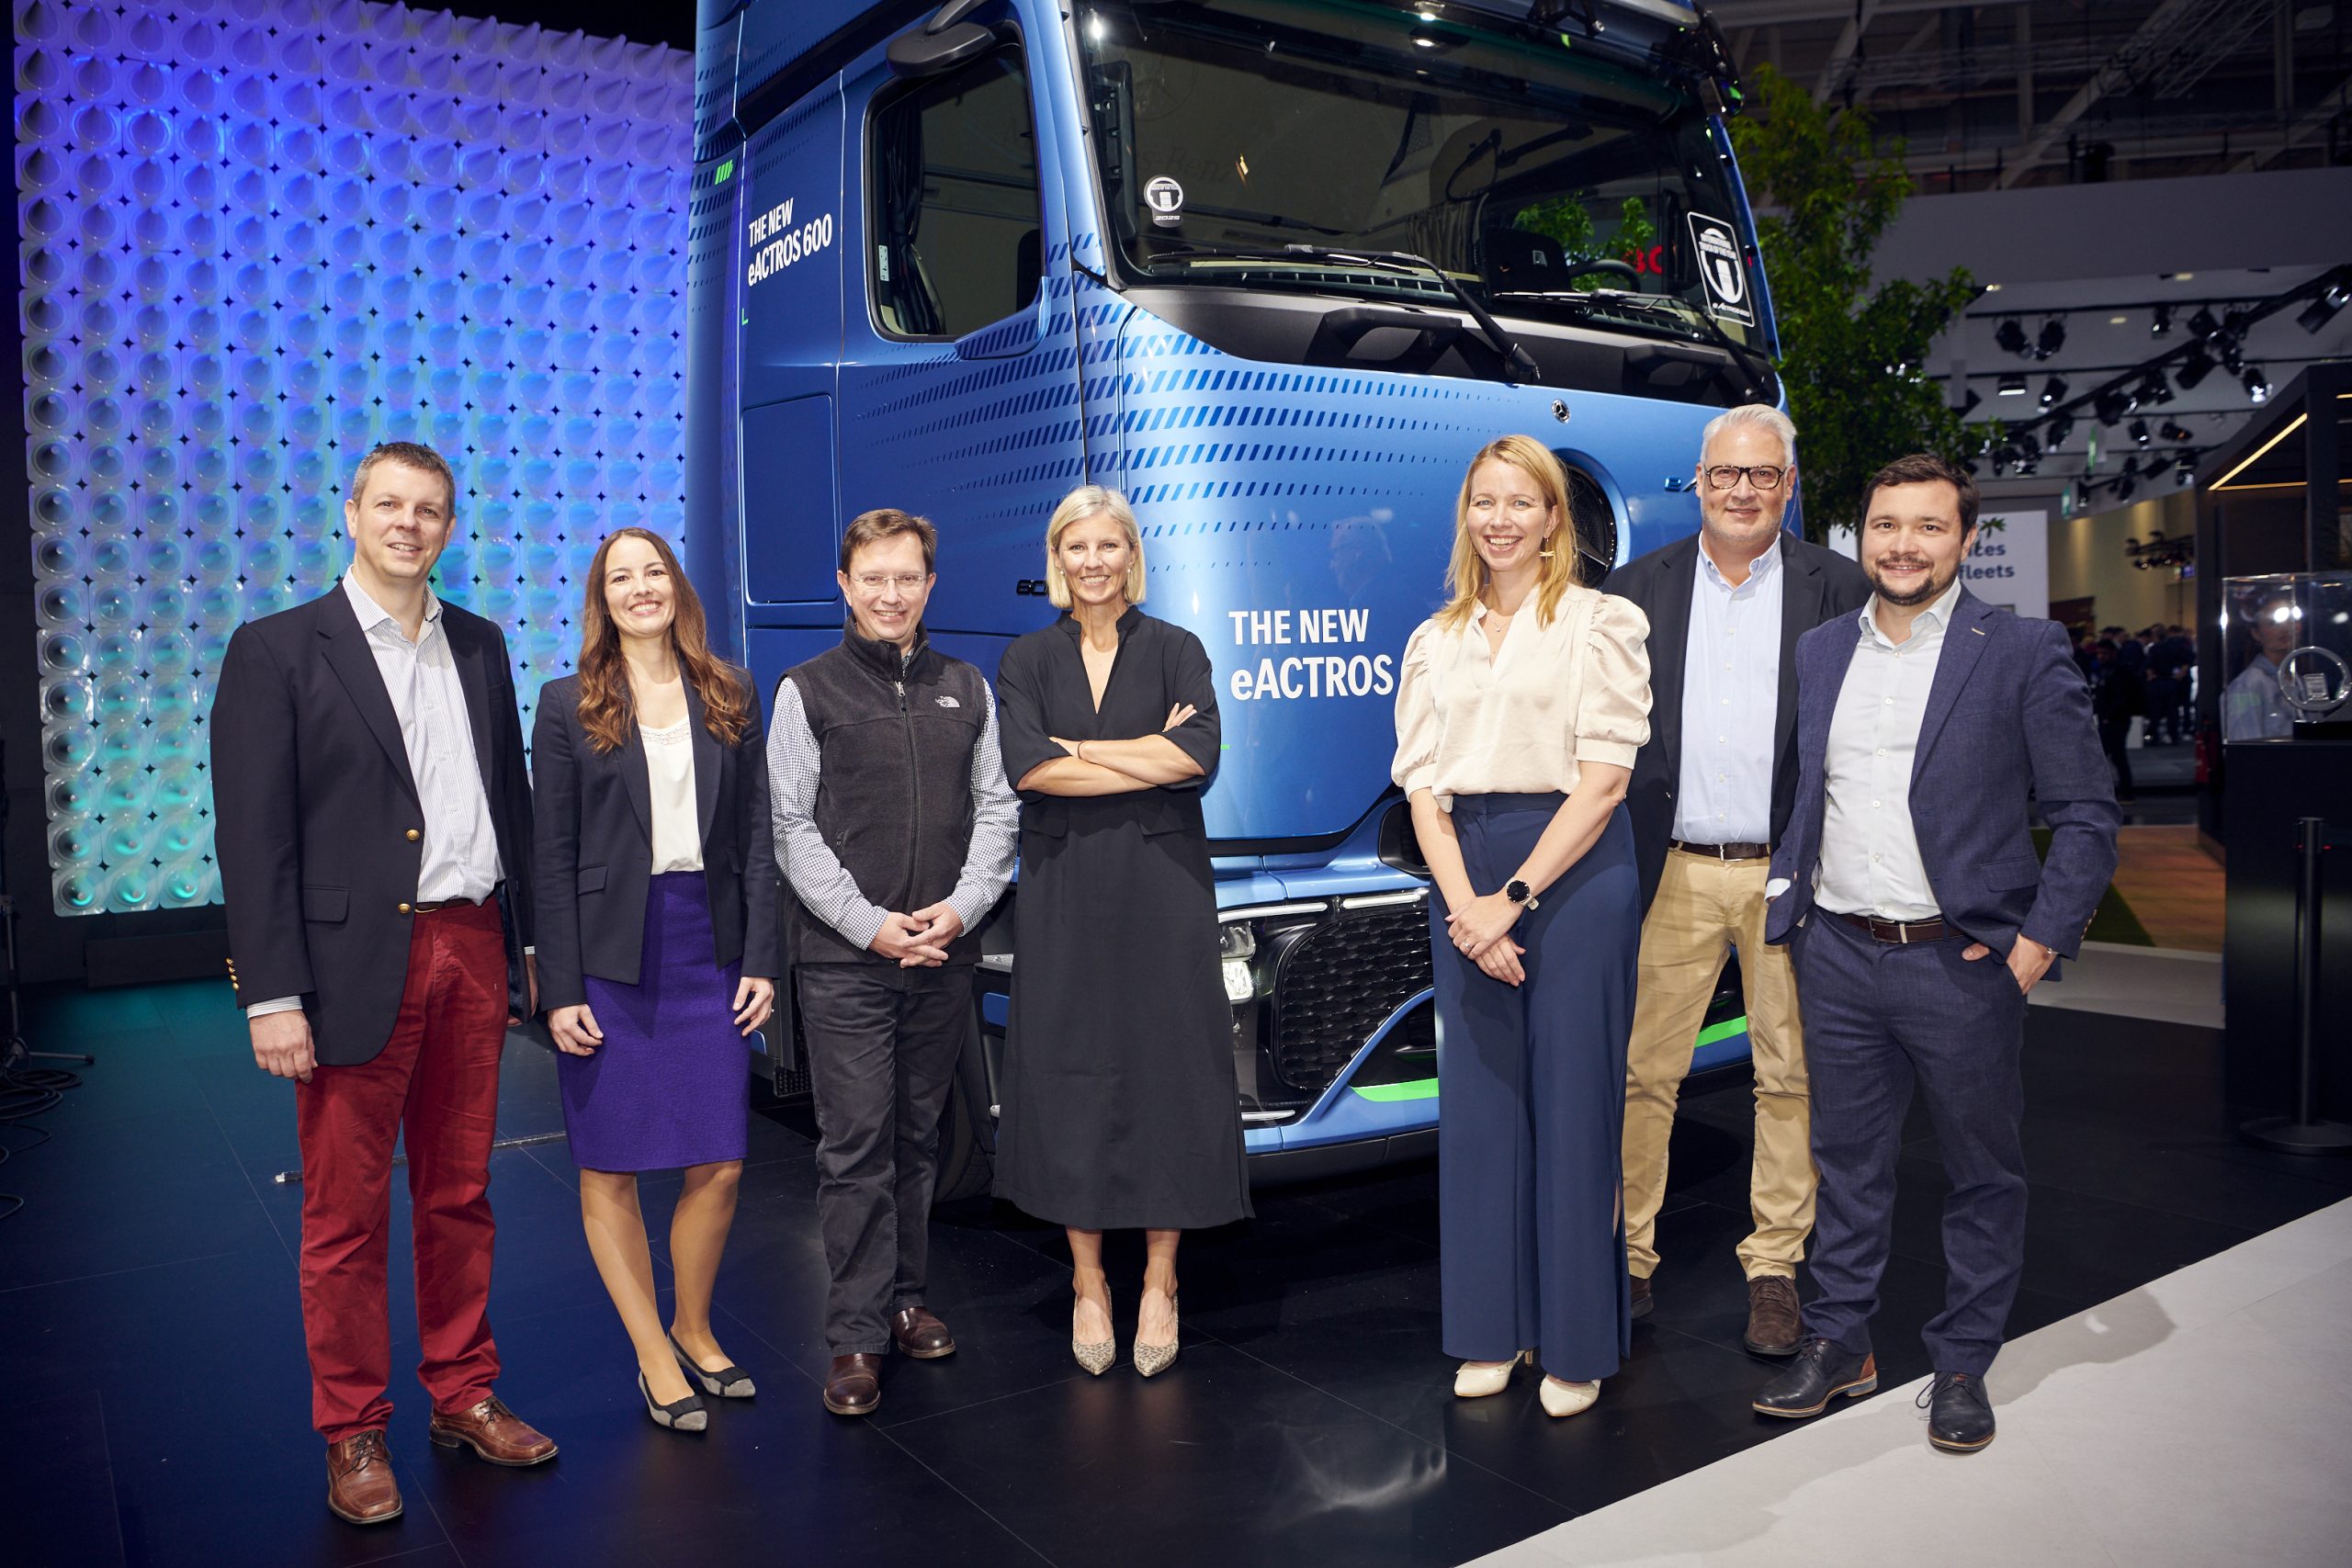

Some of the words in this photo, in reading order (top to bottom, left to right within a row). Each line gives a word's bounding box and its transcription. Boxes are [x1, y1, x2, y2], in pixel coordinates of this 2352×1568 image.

[749, 214, 767, 248] THE
[768, 197, 794, 236] NEW
[748, 229, 801, 287] eACTROS
[803, 213, 832, 256] 600
[1958, 564, 2015, 580] fleets
[1227, 610, 1292, 645] THE
[1299, 608, 1369, 643] NEW
[1230, 654, 1394, 701] eACTROS
